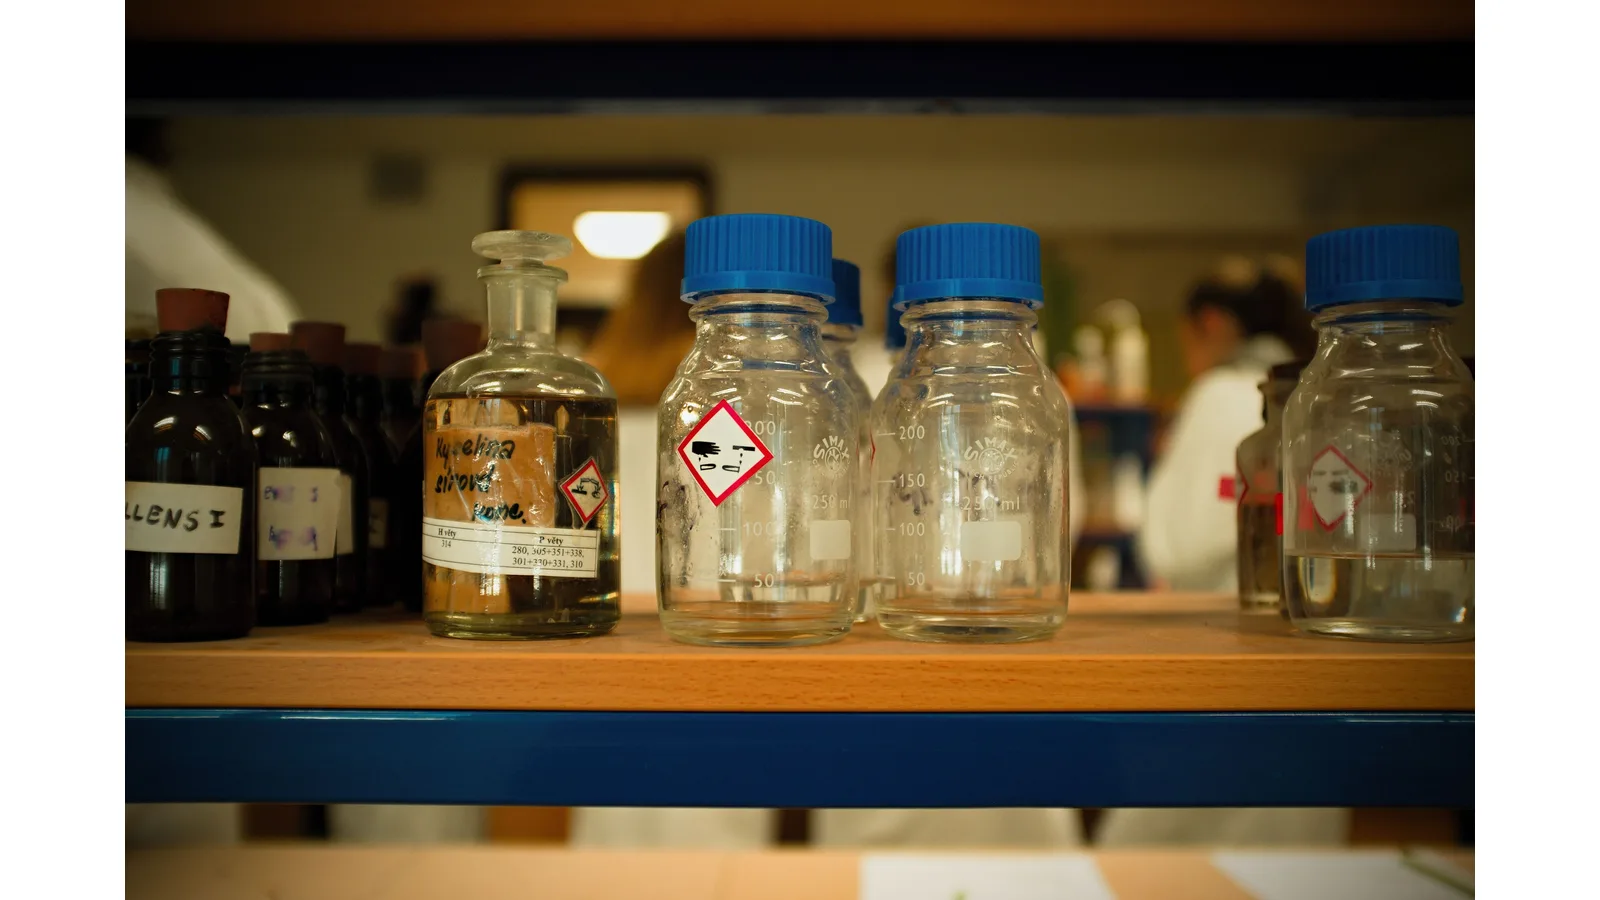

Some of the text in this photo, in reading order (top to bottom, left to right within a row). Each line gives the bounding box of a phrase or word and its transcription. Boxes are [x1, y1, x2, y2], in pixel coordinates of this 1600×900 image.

[899, 425, 926, 440] 200
[813, 435, 850, 460] SIMAX
[963, 437, 1018, 461] SIMAX
[747, 471, 777, 486] 50
[899, 473, 926, 488] 150
[812, 494, 837, 509] 250
[962, 496, 1020, 511] 250 ml
[438, 528, 444, 536] H
[744, 521, 777, 537] 100
[899, 522, 925, 537] 100
[441, 540, 452, 548] 314
[539, 536, 564, 546] P věty
[512, 546, 529, 556] 280,
[571, 560, 583, 569] 310
[754, 573, 774, 588] 50
[908, 571, 925, 586] 50
